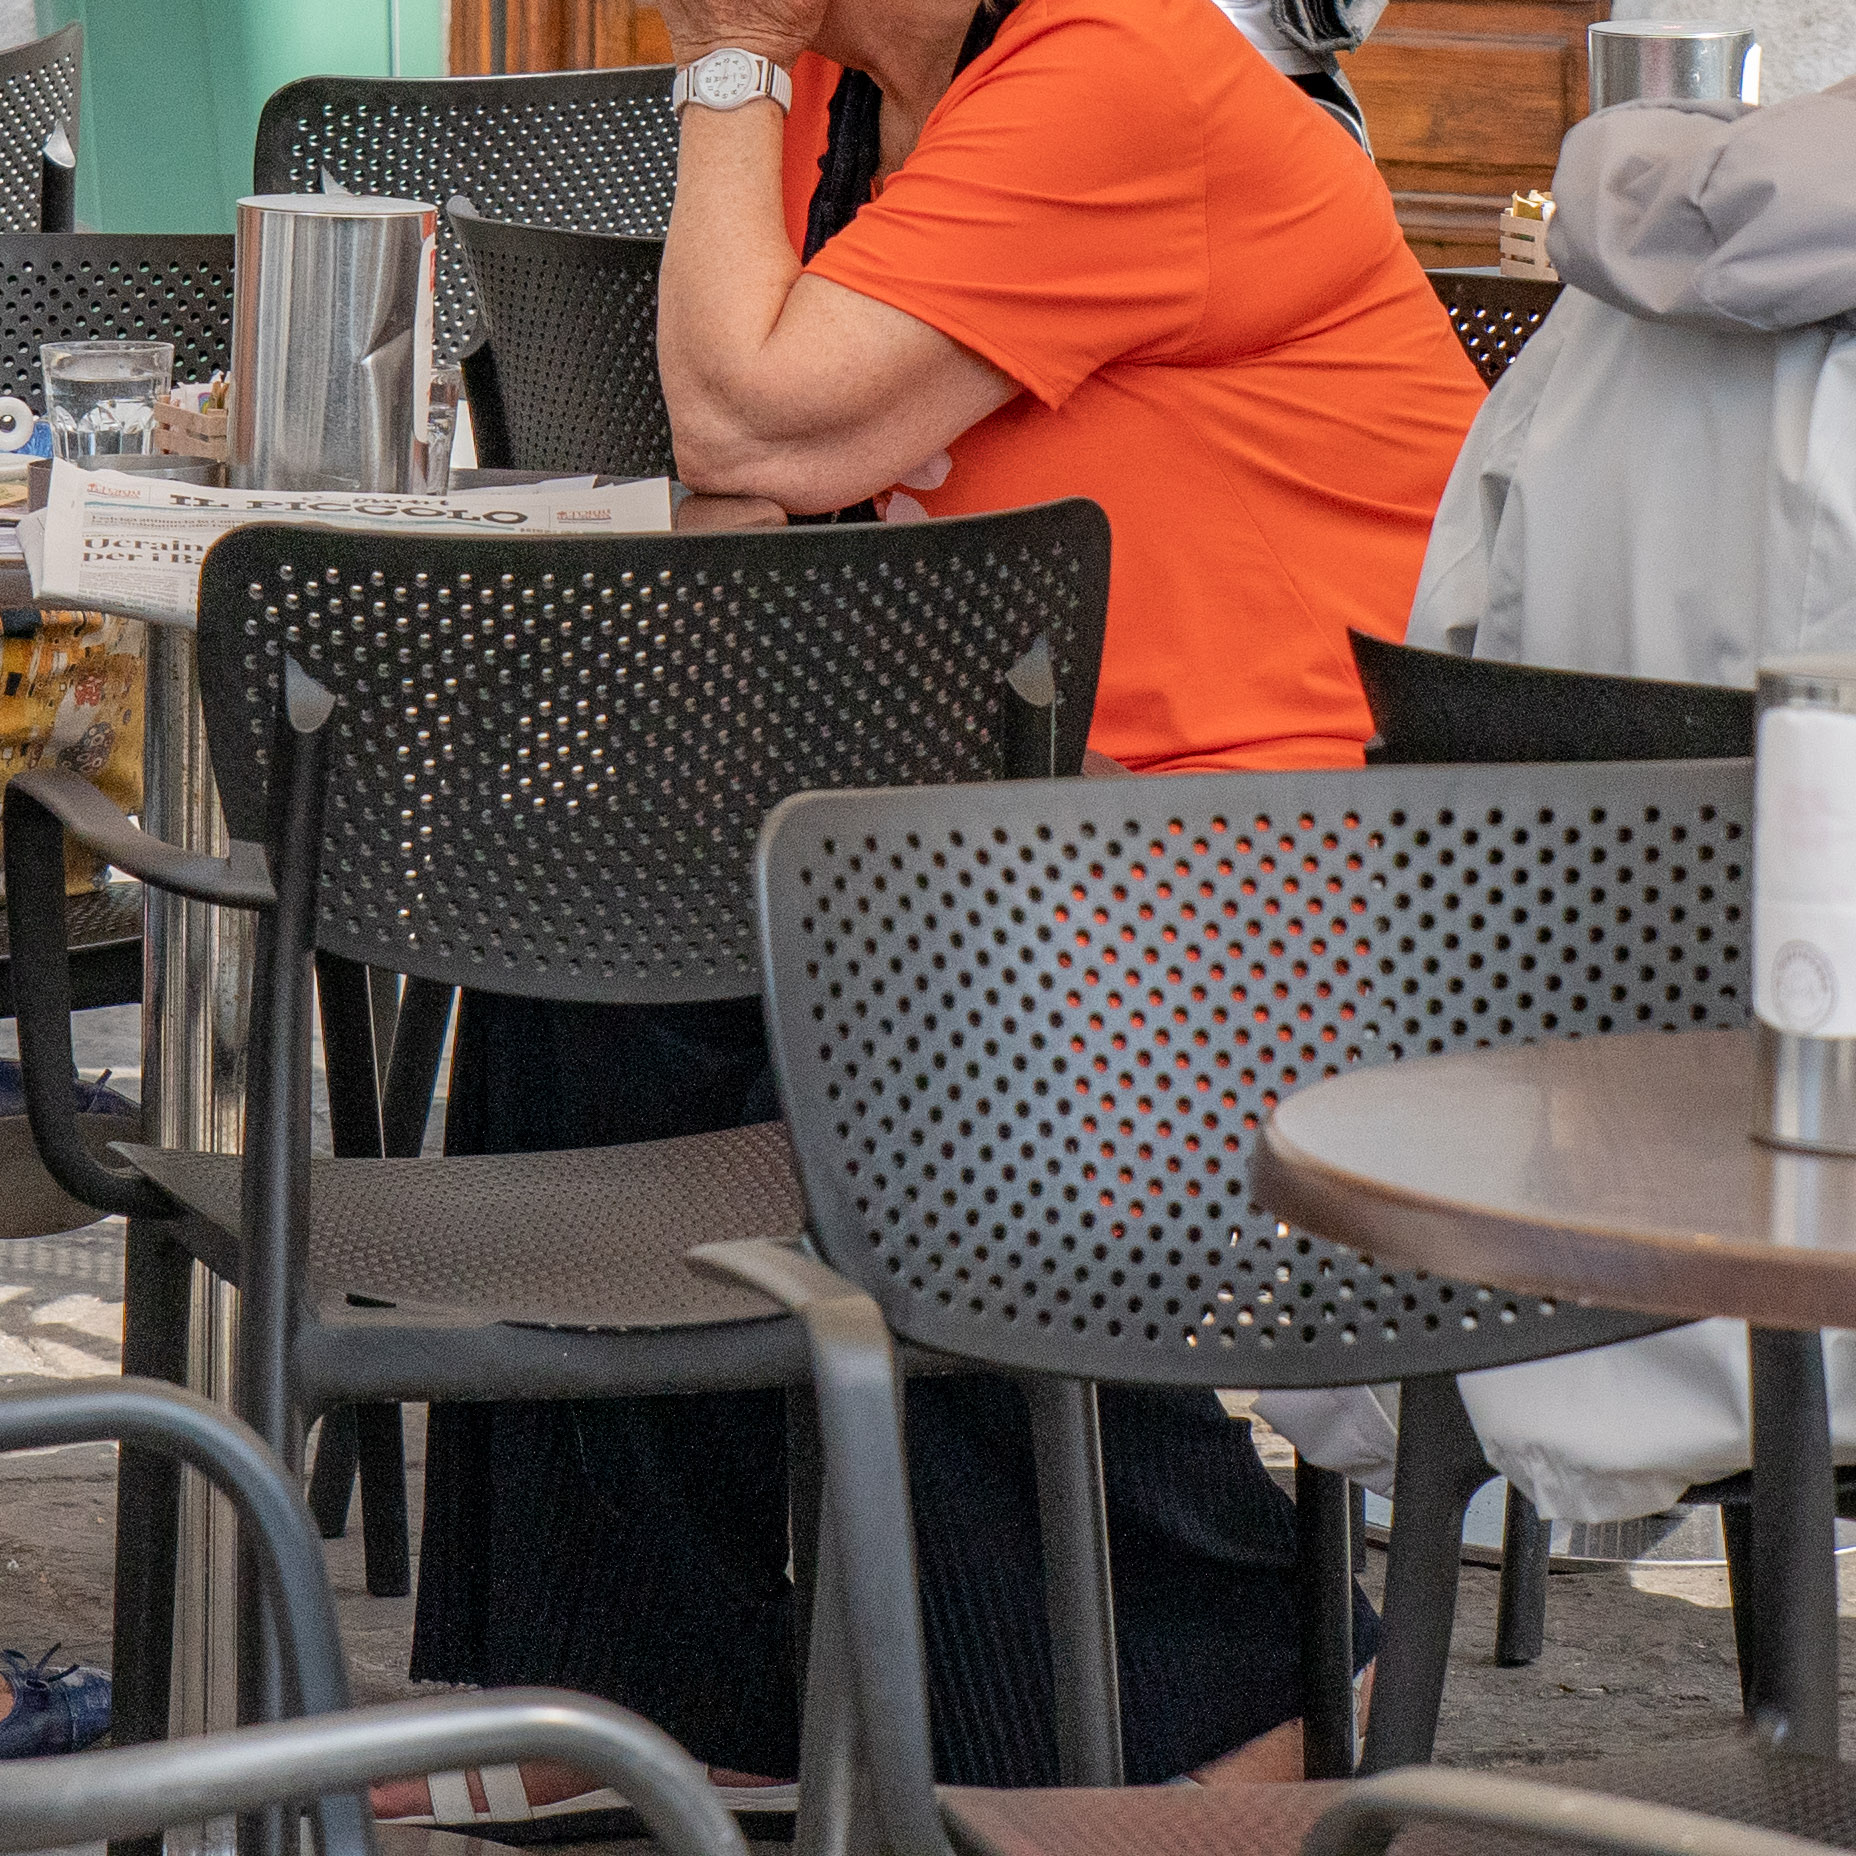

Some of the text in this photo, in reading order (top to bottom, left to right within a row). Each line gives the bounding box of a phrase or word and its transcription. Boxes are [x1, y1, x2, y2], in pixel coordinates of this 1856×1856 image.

[169, 494, 230, 508] IL
[246, 500, 528, 524] PICCOLO
[84, 538, 204, 553] Ucrain
[83, 552, 143, 562] per
[152, 553, 159, 562] i
